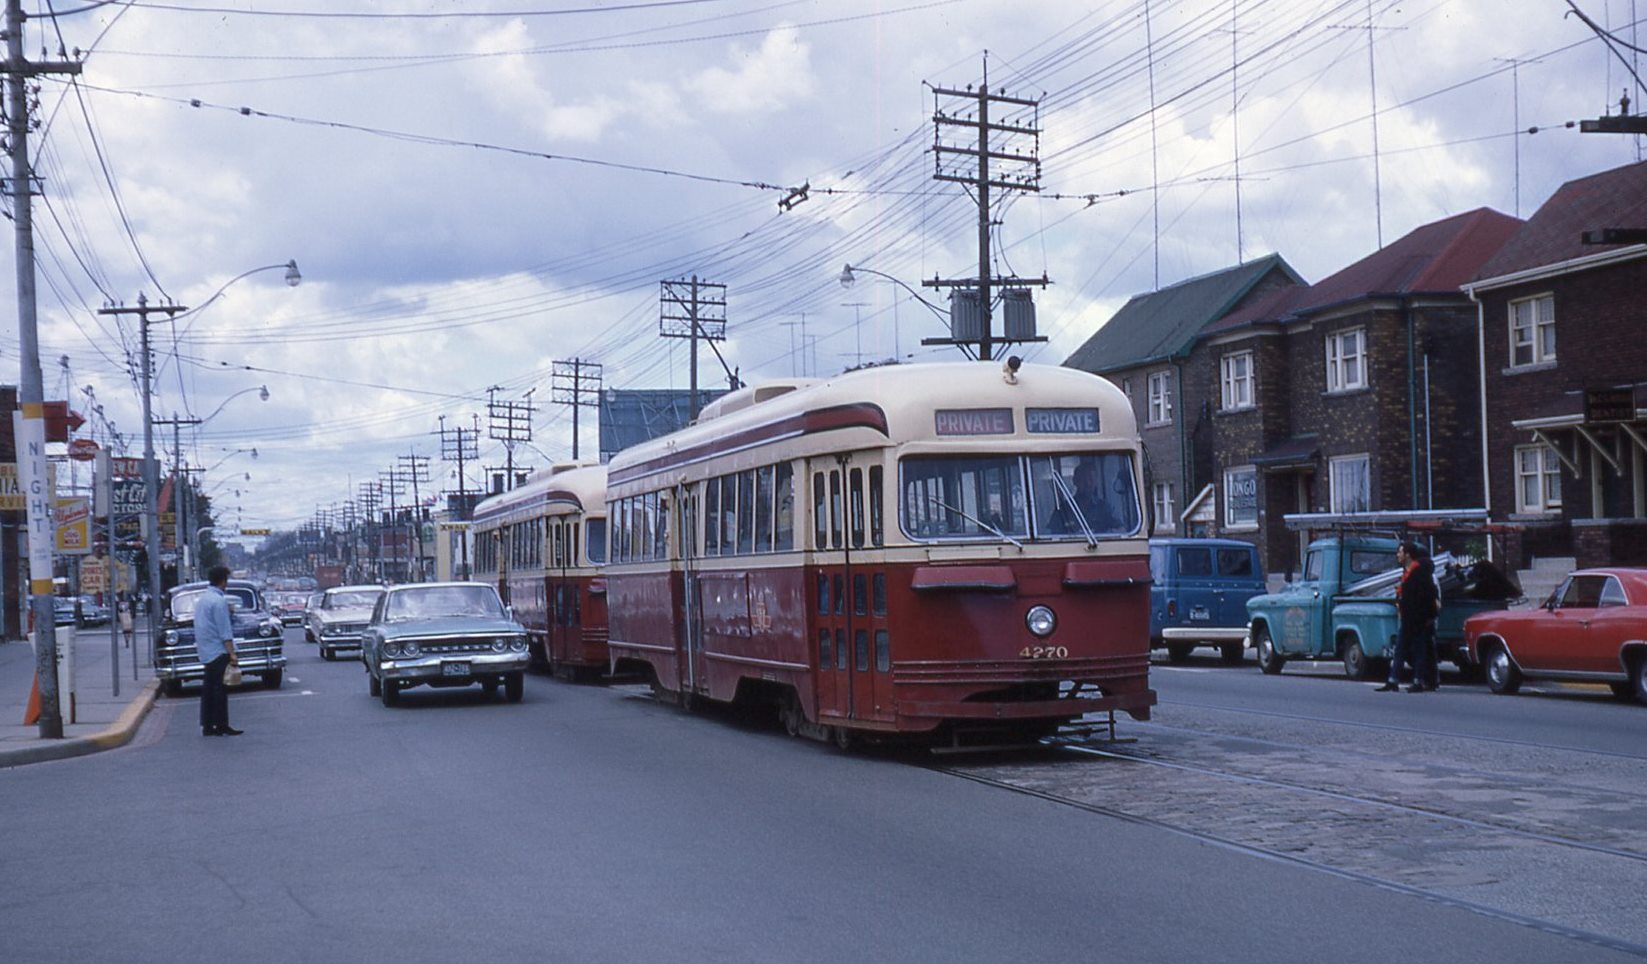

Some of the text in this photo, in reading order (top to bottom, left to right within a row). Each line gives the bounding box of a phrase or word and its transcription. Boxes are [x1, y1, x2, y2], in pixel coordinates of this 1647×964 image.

[937, 413, 1003, 432] PRIVATE
[1028, 412, 1094, 431] PRIVATE
[29, 441, 43, 533] NIGHT
[82, 576, 101, 584] CAR
[1019, 646, 1069, 658] 4270
